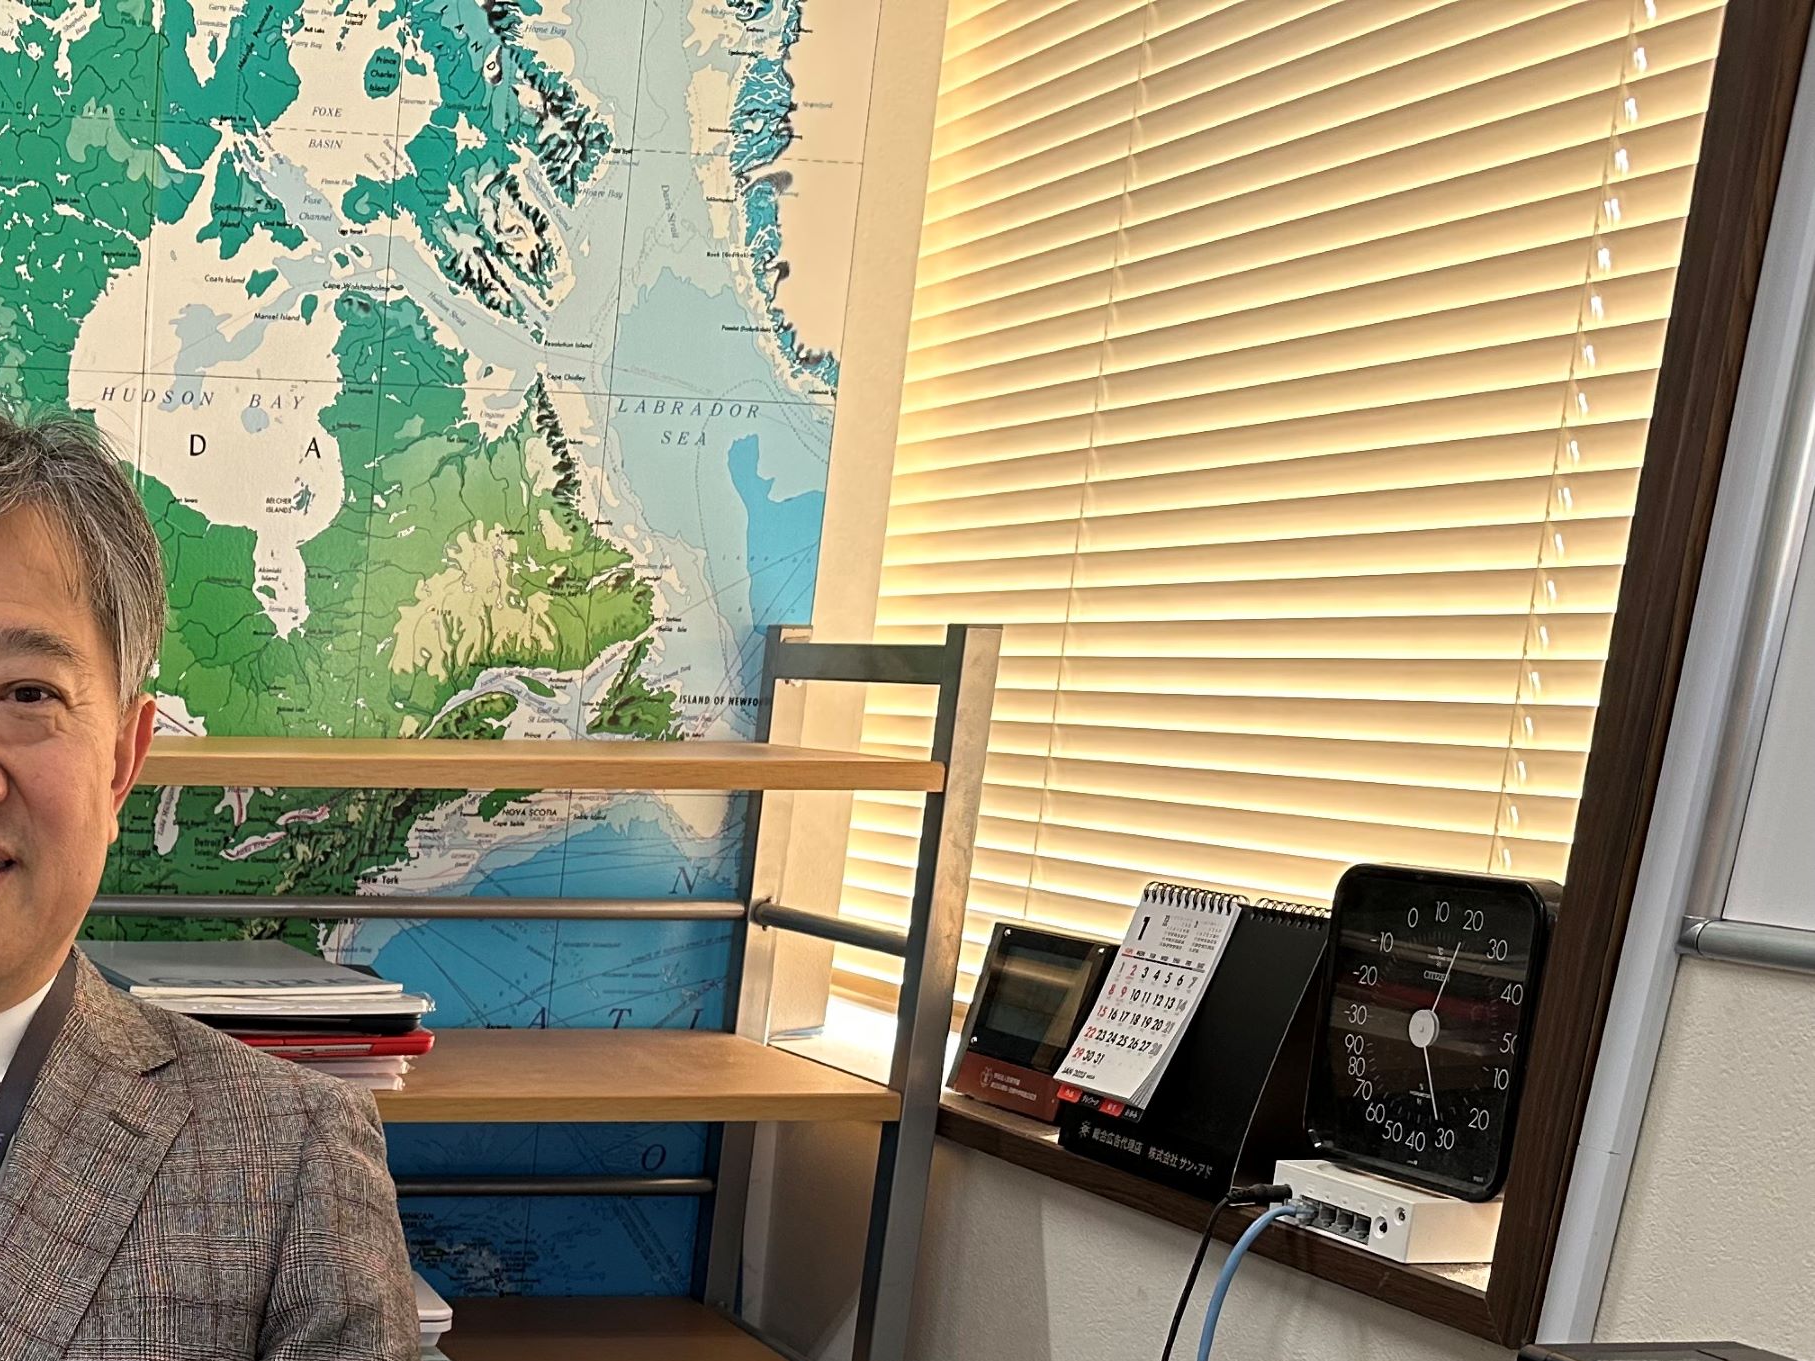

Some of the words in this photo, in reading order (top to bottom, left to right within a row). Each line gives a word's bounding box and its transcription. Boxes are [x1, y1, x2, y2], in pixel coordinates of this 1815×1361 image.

[376, 56, 397, 65] Prince
[371, 70, 395, 79] Charles
[369, 84, 391, 92] Island
[312, 106, 342, 118] FOXE
[308, 139, 342, 150] BASIN
[303, 195, 322, 205] Foxe
[299, 212, 332, 222] Channel
[205, 275, 223, 283] Coats
[225, 276, 245, 284] Island
[254, 313, 278, 321] Mansel
[101, 387, 214, 406] HUDSON
[249, 394, 304, 410] BAY
[617, 399, 760, 419] LABRADOR
[661, 431, 707, 446] SEA
[679, 695, 711, 705] ISLAND
[714, 696, 725, 705] OF
[502, 809, 526, 817] NOVA
[528, 809, 557, 817] SCOTIA
[362, 876, 379, 884] New
[382, 875, 399, 884] York
[1408, 908, 1418, 928] 0
[1436, 901, 1450, 922] 10
[1463, 910, 1484, 932] 20
[1138, 917, 1150, 940] 1
[1370, 932, 1393, 952] -10
[1486, 939, 1507, 960] 30
[1130, 965, 1137, 976] 2
[1141, 967, 1149, 978] 3
[1153, 970, 1160, 981] 4
[1165, 972, 1173, 984] 5
[1177, 975, 1183, 986] 6
[1353, 965, 1377, 986] -20
[1130, 989, 1141, 1001] 10
[1142, 991, 1151, 1003] 11
[1152, 994, 1163, 1006] 12
[1165, 997, 1175, 1009] 13
[1501, 984, 1523, 1005] 40
[1108, 1008, 1118, 1020] 16
[1120, 1010, 1130, 1022] 17
[1130, 1013, 1141, 1025] 18
[1141, 1015, 1151, 1028] 19
[1151, 1019, 1163, 1031] 20
[1344, 1004, 1367, 1025] -30
[1096, 1029, 1106, 1041] 23
[1106, 1032, 1117, 1044] 24
[1116, 1035, 1127, 1047] 25
[1128, 1038, 1138, 1049] 26
[1139, 1041, 1151, 1052] 27
[1345, 1034, 1364, 1055] 90
[1083, 1050, 1094, 1062] 30
[1093, 1053, 1105, 1065] 31
[1348, 1057, 1365, 1077] 80
[1353, 1078, 1372, 1100] 70
[1494, 1068, 1509, 1090] 10
[1366, 1103, 1385, 1124] 60
[1469, 1108, 1489, 1130] 20
[1382, 1121, 1403, 1142] 50
[1406, 1131, 1425, 1151] 40
[1435, 1128, 1455, 1150] 30
